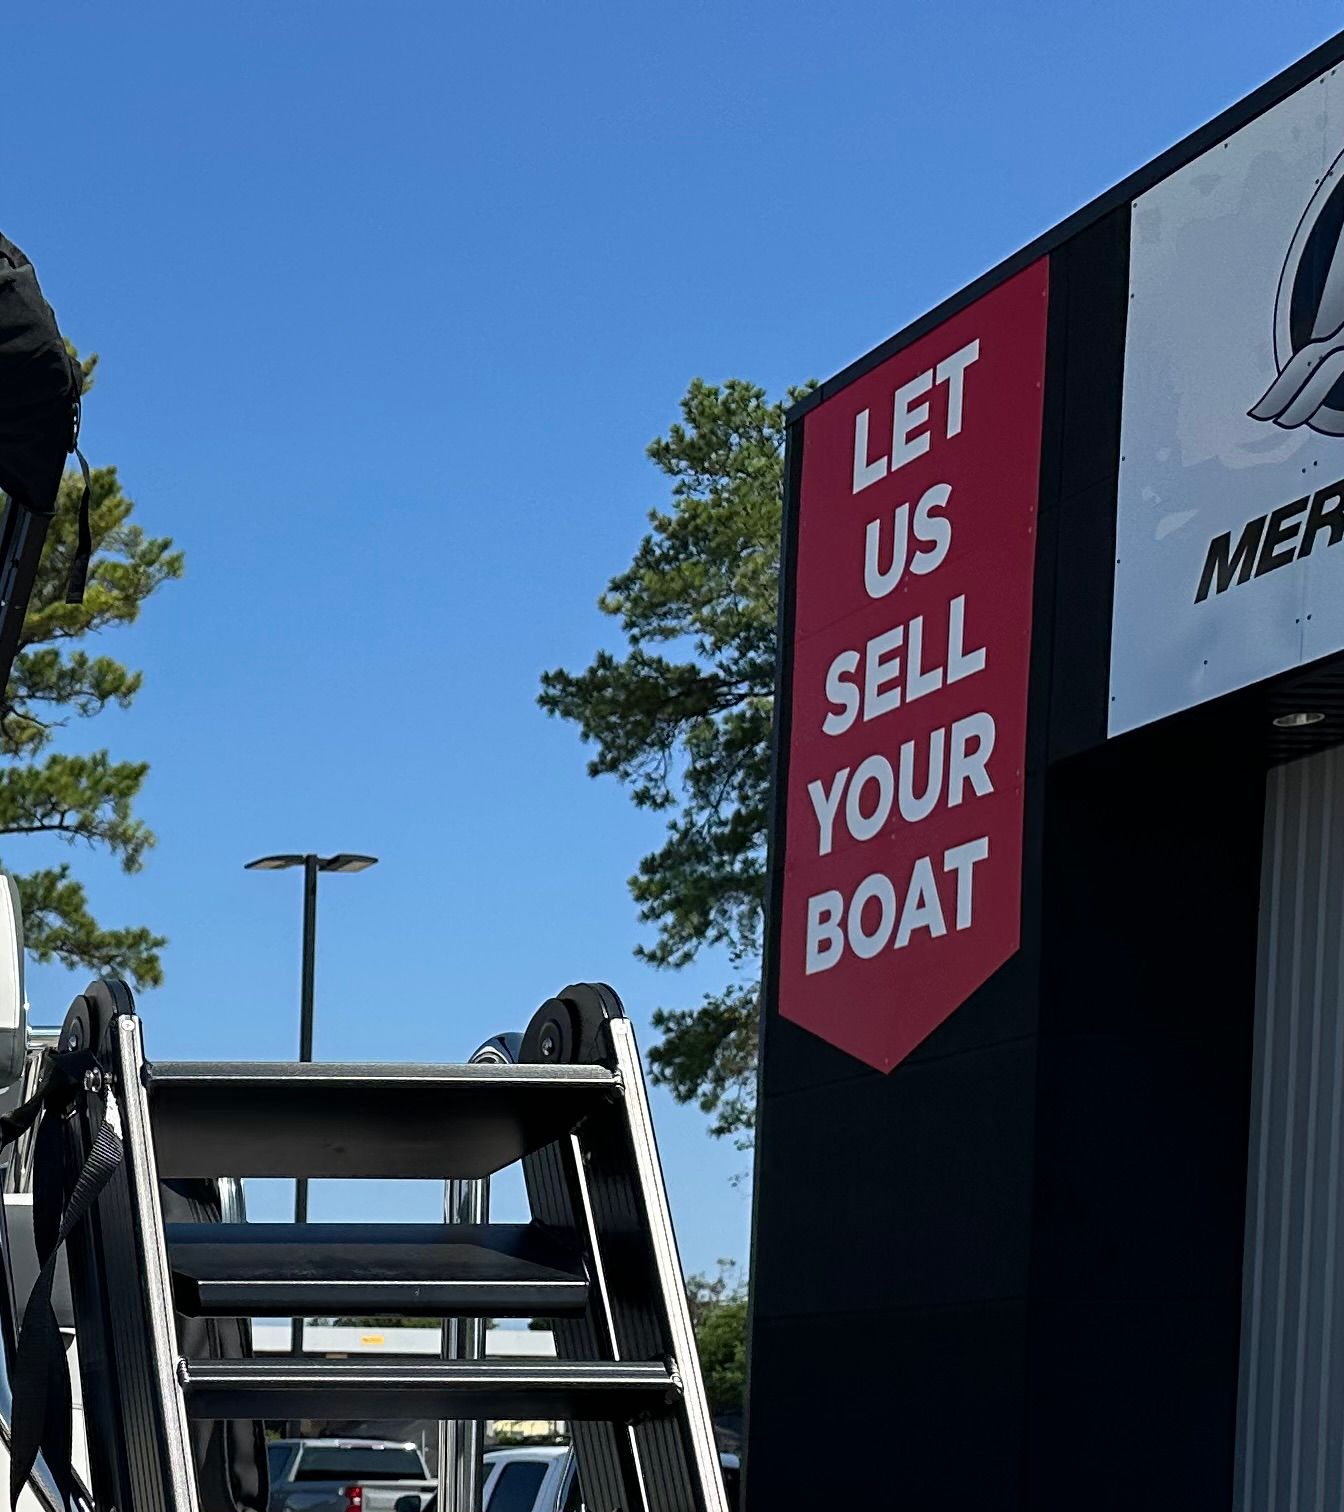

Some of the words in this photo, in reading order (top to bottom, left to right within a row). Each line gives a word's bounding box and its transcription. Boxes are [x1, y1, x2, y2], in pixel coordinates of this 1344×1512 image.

[852, 338, 980, 495] LET
[863, 482, 953, 599] US
[822, 594, 987, 737] SELL
[807, 711, 996, 856] YOUR
[805, 836, 989, 976] BOAT
